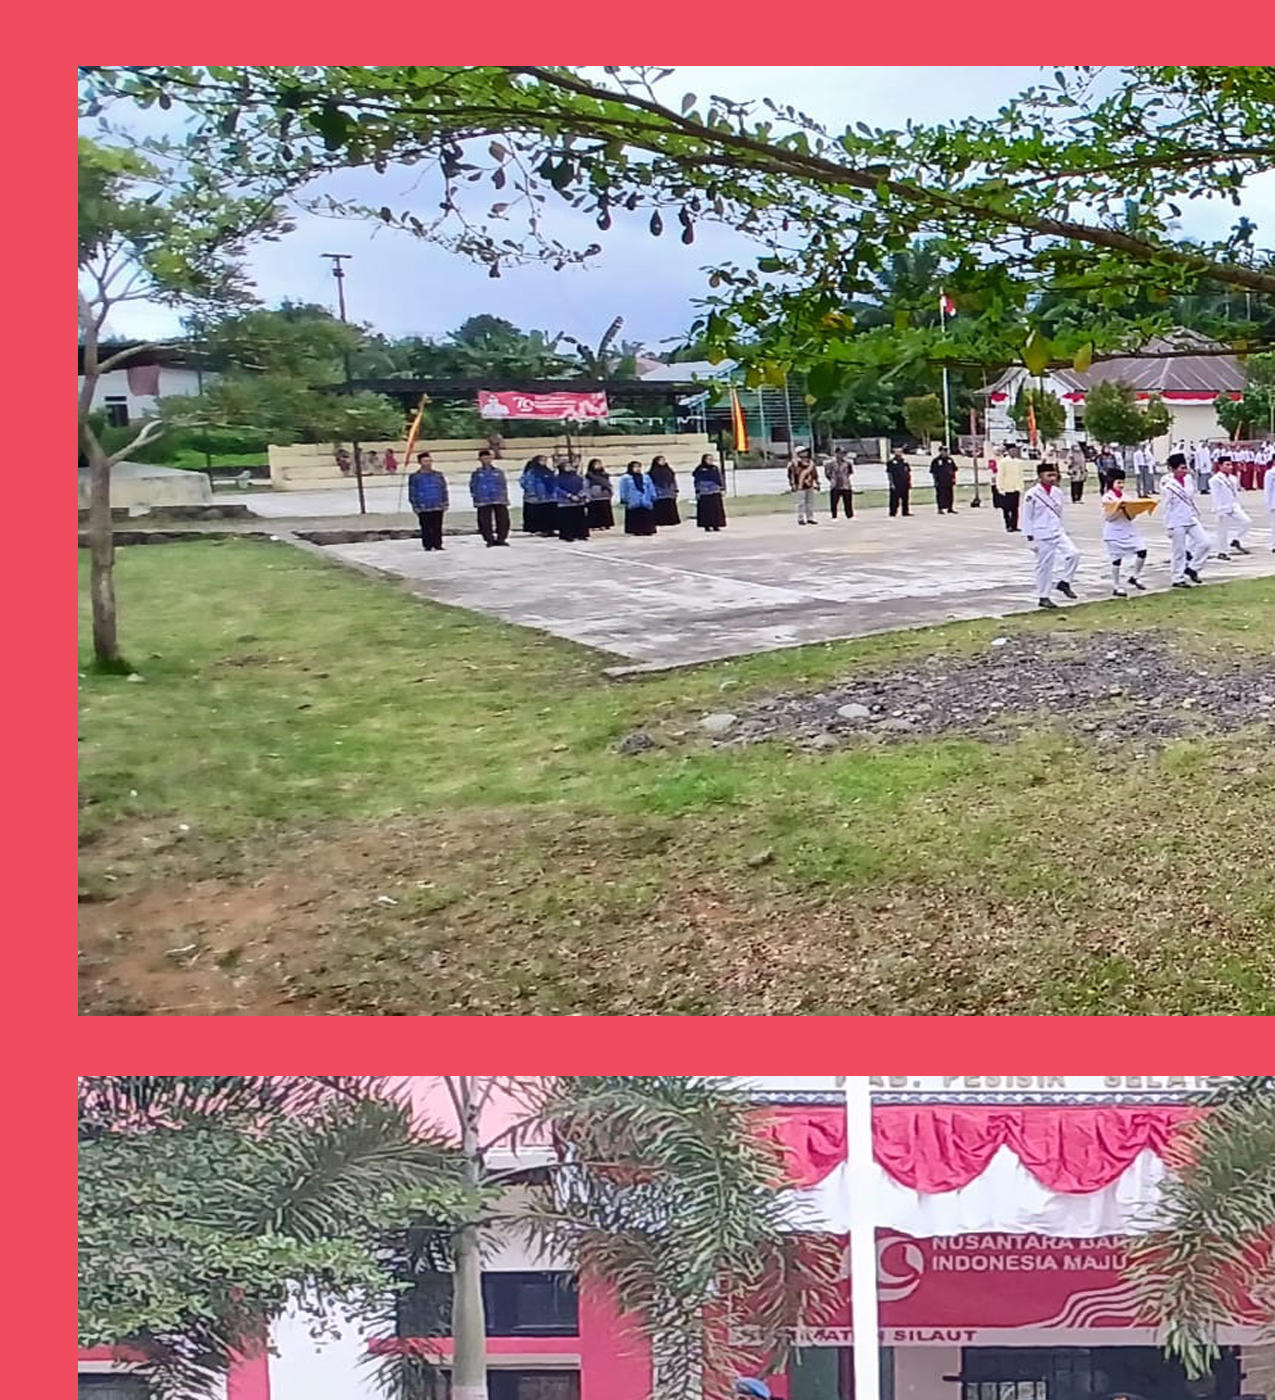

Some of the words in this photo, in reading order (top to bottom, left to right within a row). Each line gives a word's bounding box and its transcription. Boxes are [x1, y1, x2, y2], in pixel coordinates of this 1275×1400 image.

[932, 1255, 1058, 1271] INDONESIA
[1063, 1254, 1127, 1271] MAJU
[893, 1330, 976, 1342] SILAUT
